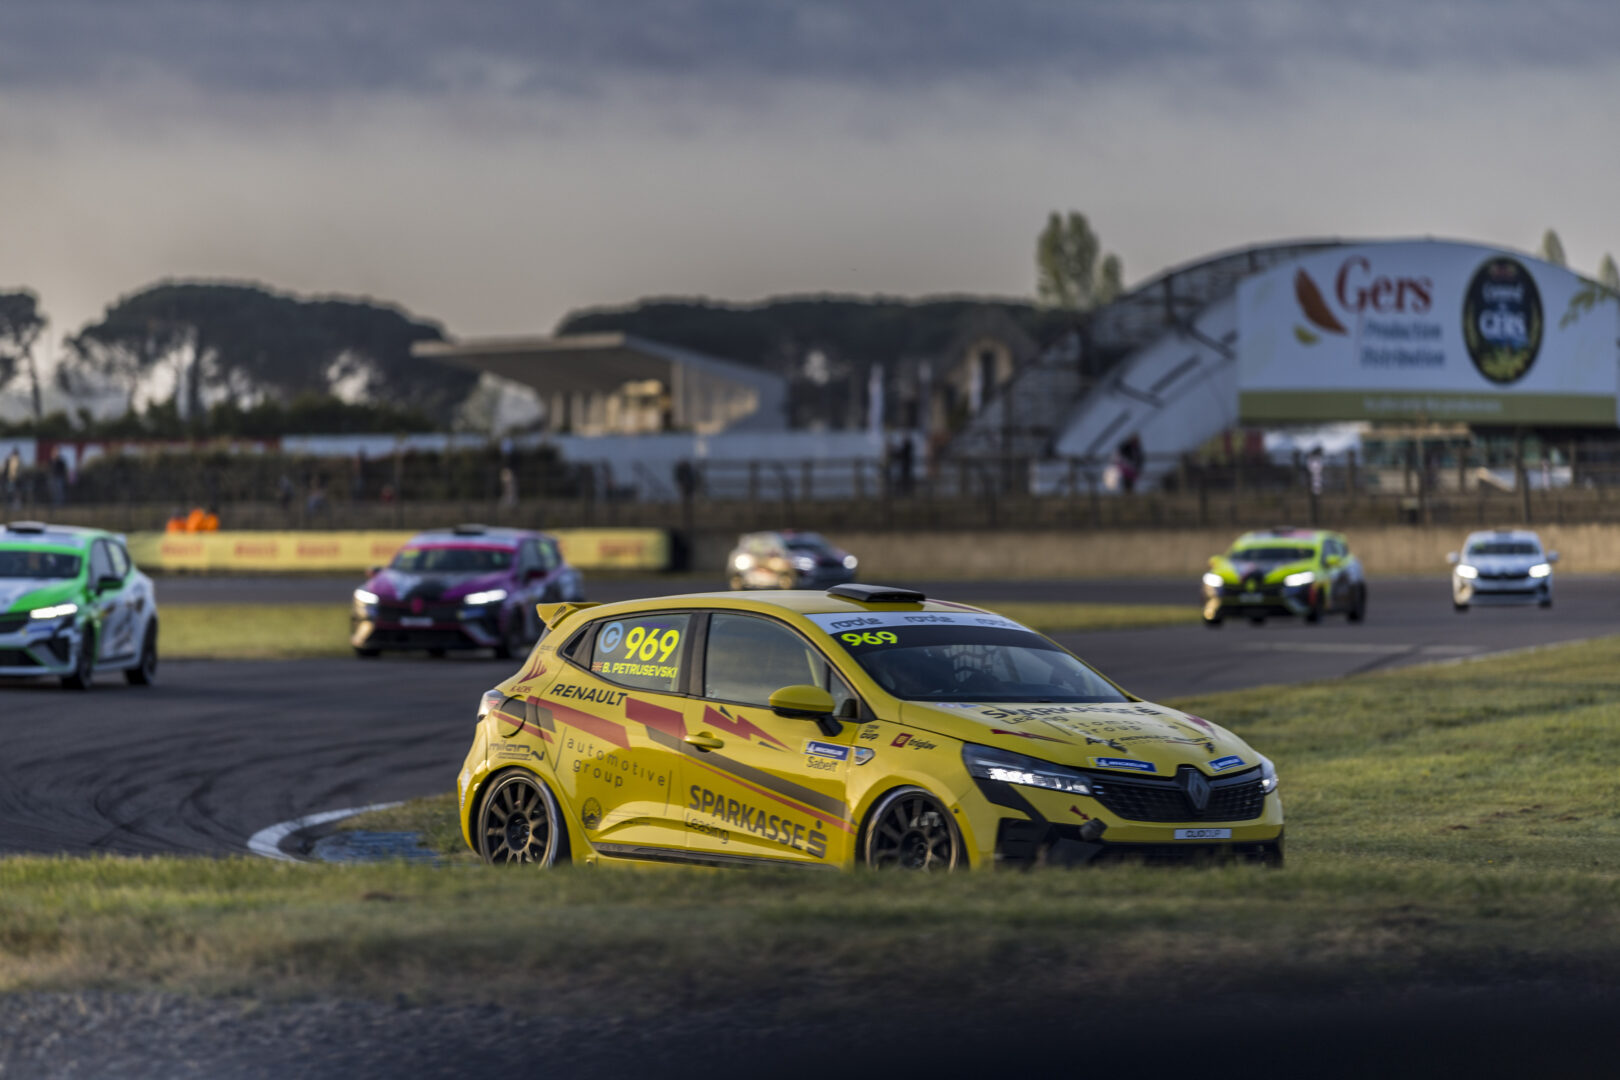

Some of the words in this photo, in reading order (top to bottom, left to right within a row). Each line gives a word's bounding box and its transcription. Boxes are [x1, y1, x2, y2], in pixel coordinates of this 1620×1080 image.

[1335, 255, 1433, 314] Gers
[624, 626, 680, 662] 969
[841, 631, 898, 647] 969
[602, 662, 612, 673] B.
[612, 662, 679, 678] PETRUSEVSKI
[550, 683, 628, 706] RENAULT
[567, 737, 667, 786] automotive
[573, 758, 624, 788] group
[684, 812, 730, 844] Leasing
[688, 784, 806, 851] SPARKASSE
